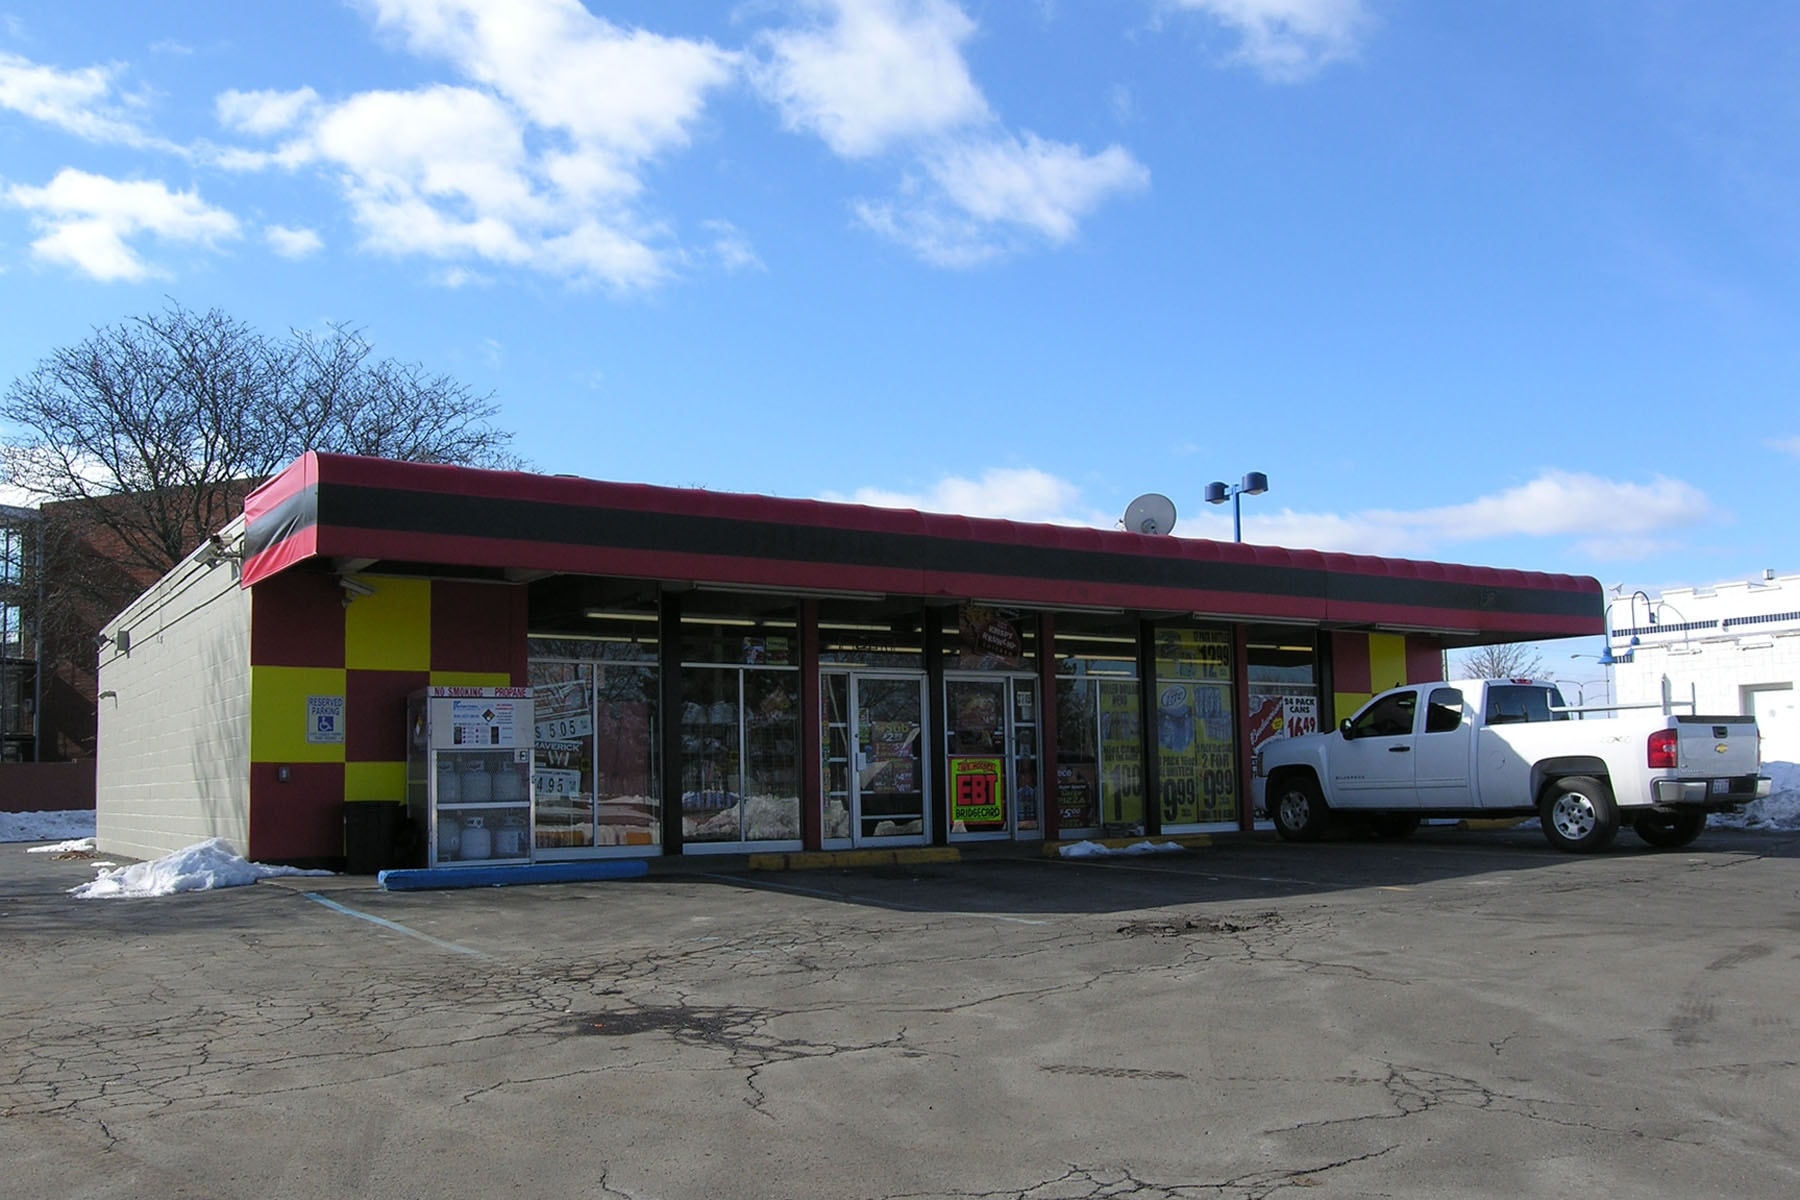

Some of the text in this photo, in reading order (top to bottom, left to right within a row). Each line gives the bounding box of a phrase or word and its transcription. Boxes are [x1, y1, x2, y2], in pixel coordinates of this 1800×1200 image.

[434, 687, 527, 697] NO SMOKING PROPANE
[309, 696, 342, 706] RESERVED
[1284, 697, 1316, 706] 24 PACK
[312, 706, 340, 716] PARKING
[956, 774, 998, 806] EBT
[955, 806, 1000, 818] BRIDGECARD
